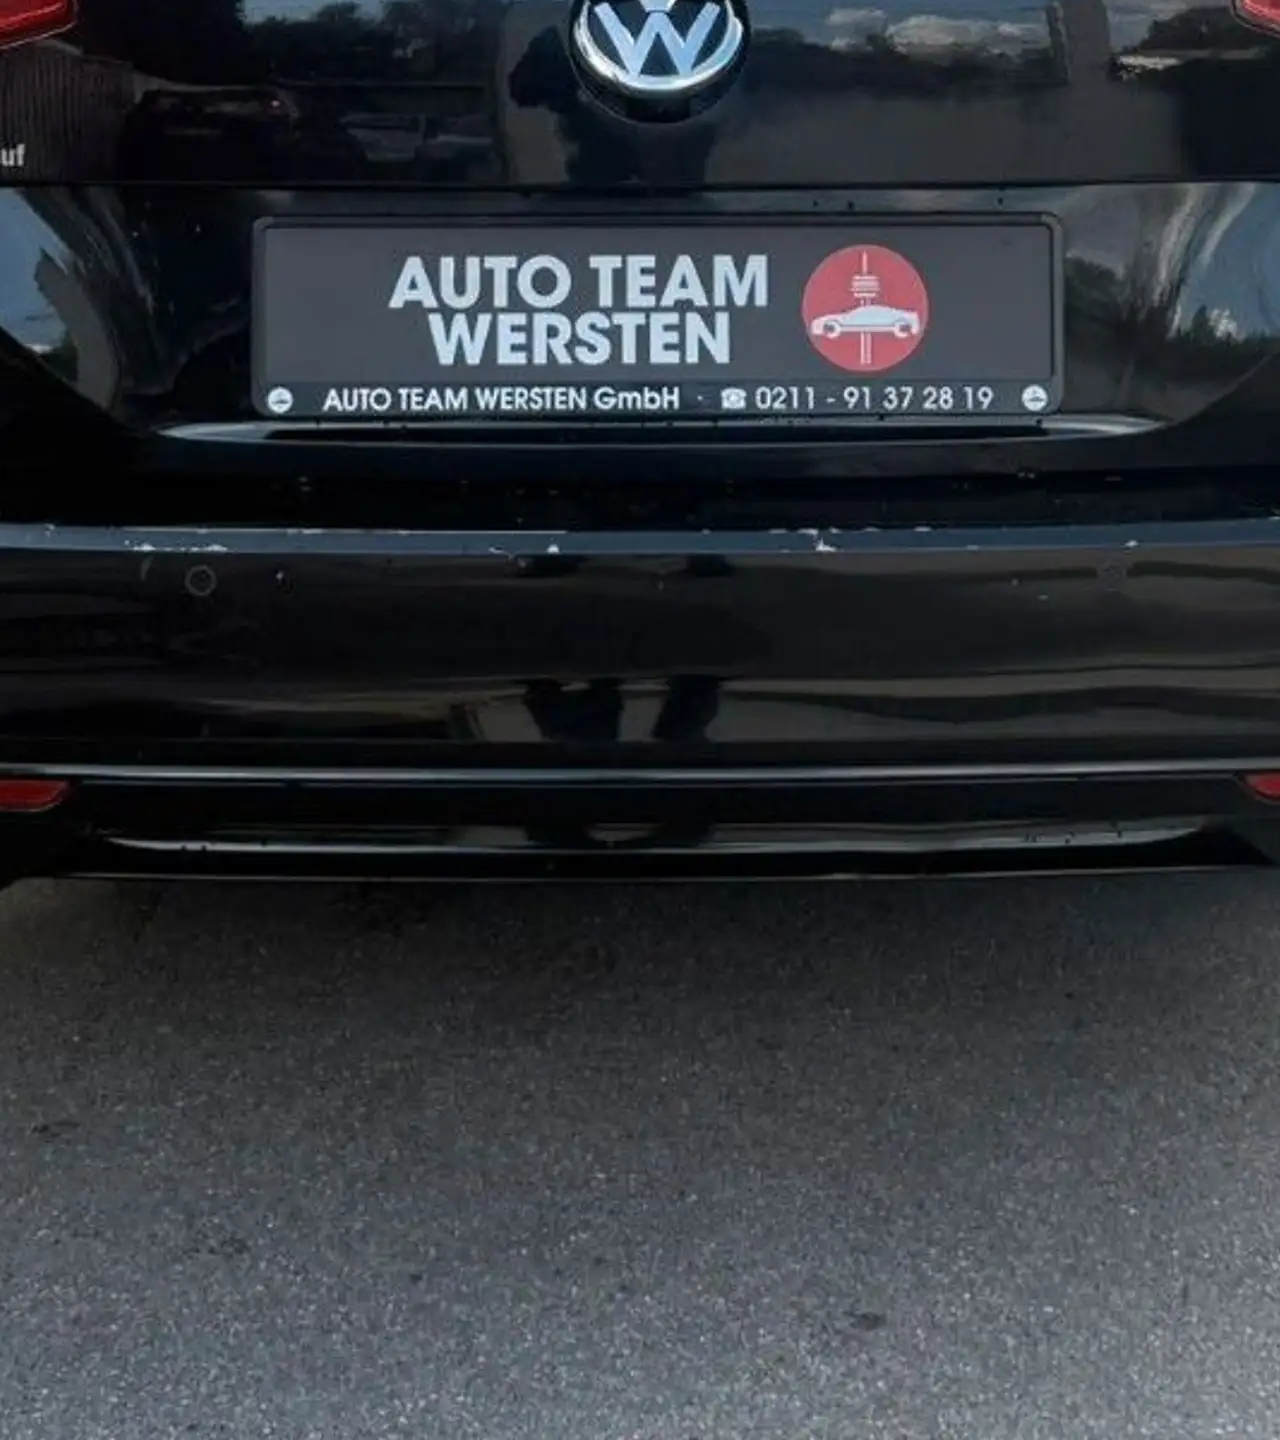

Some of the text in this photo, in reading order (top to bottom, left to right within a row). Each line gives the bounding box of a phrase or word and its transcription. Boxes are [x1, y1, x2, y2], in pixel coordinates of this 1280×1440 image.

[388, 254, 768, 309] AUTO TEAM
[428, 311, 731, 365] WERSTEN
[322, 387, 392, 412] AUTO
[398, 387, 468, 411] TEAM
[474, 387, 587, 411] WERSTEN
[593, 386, 681, 411] GmbH
[754, 385, 816, 410] 0211
[842, 386, 871, 410] 91
[882, 385, 914, 410] 37
[922, 385, 954, 410] 28
[963, 385, 994, 410] 19
